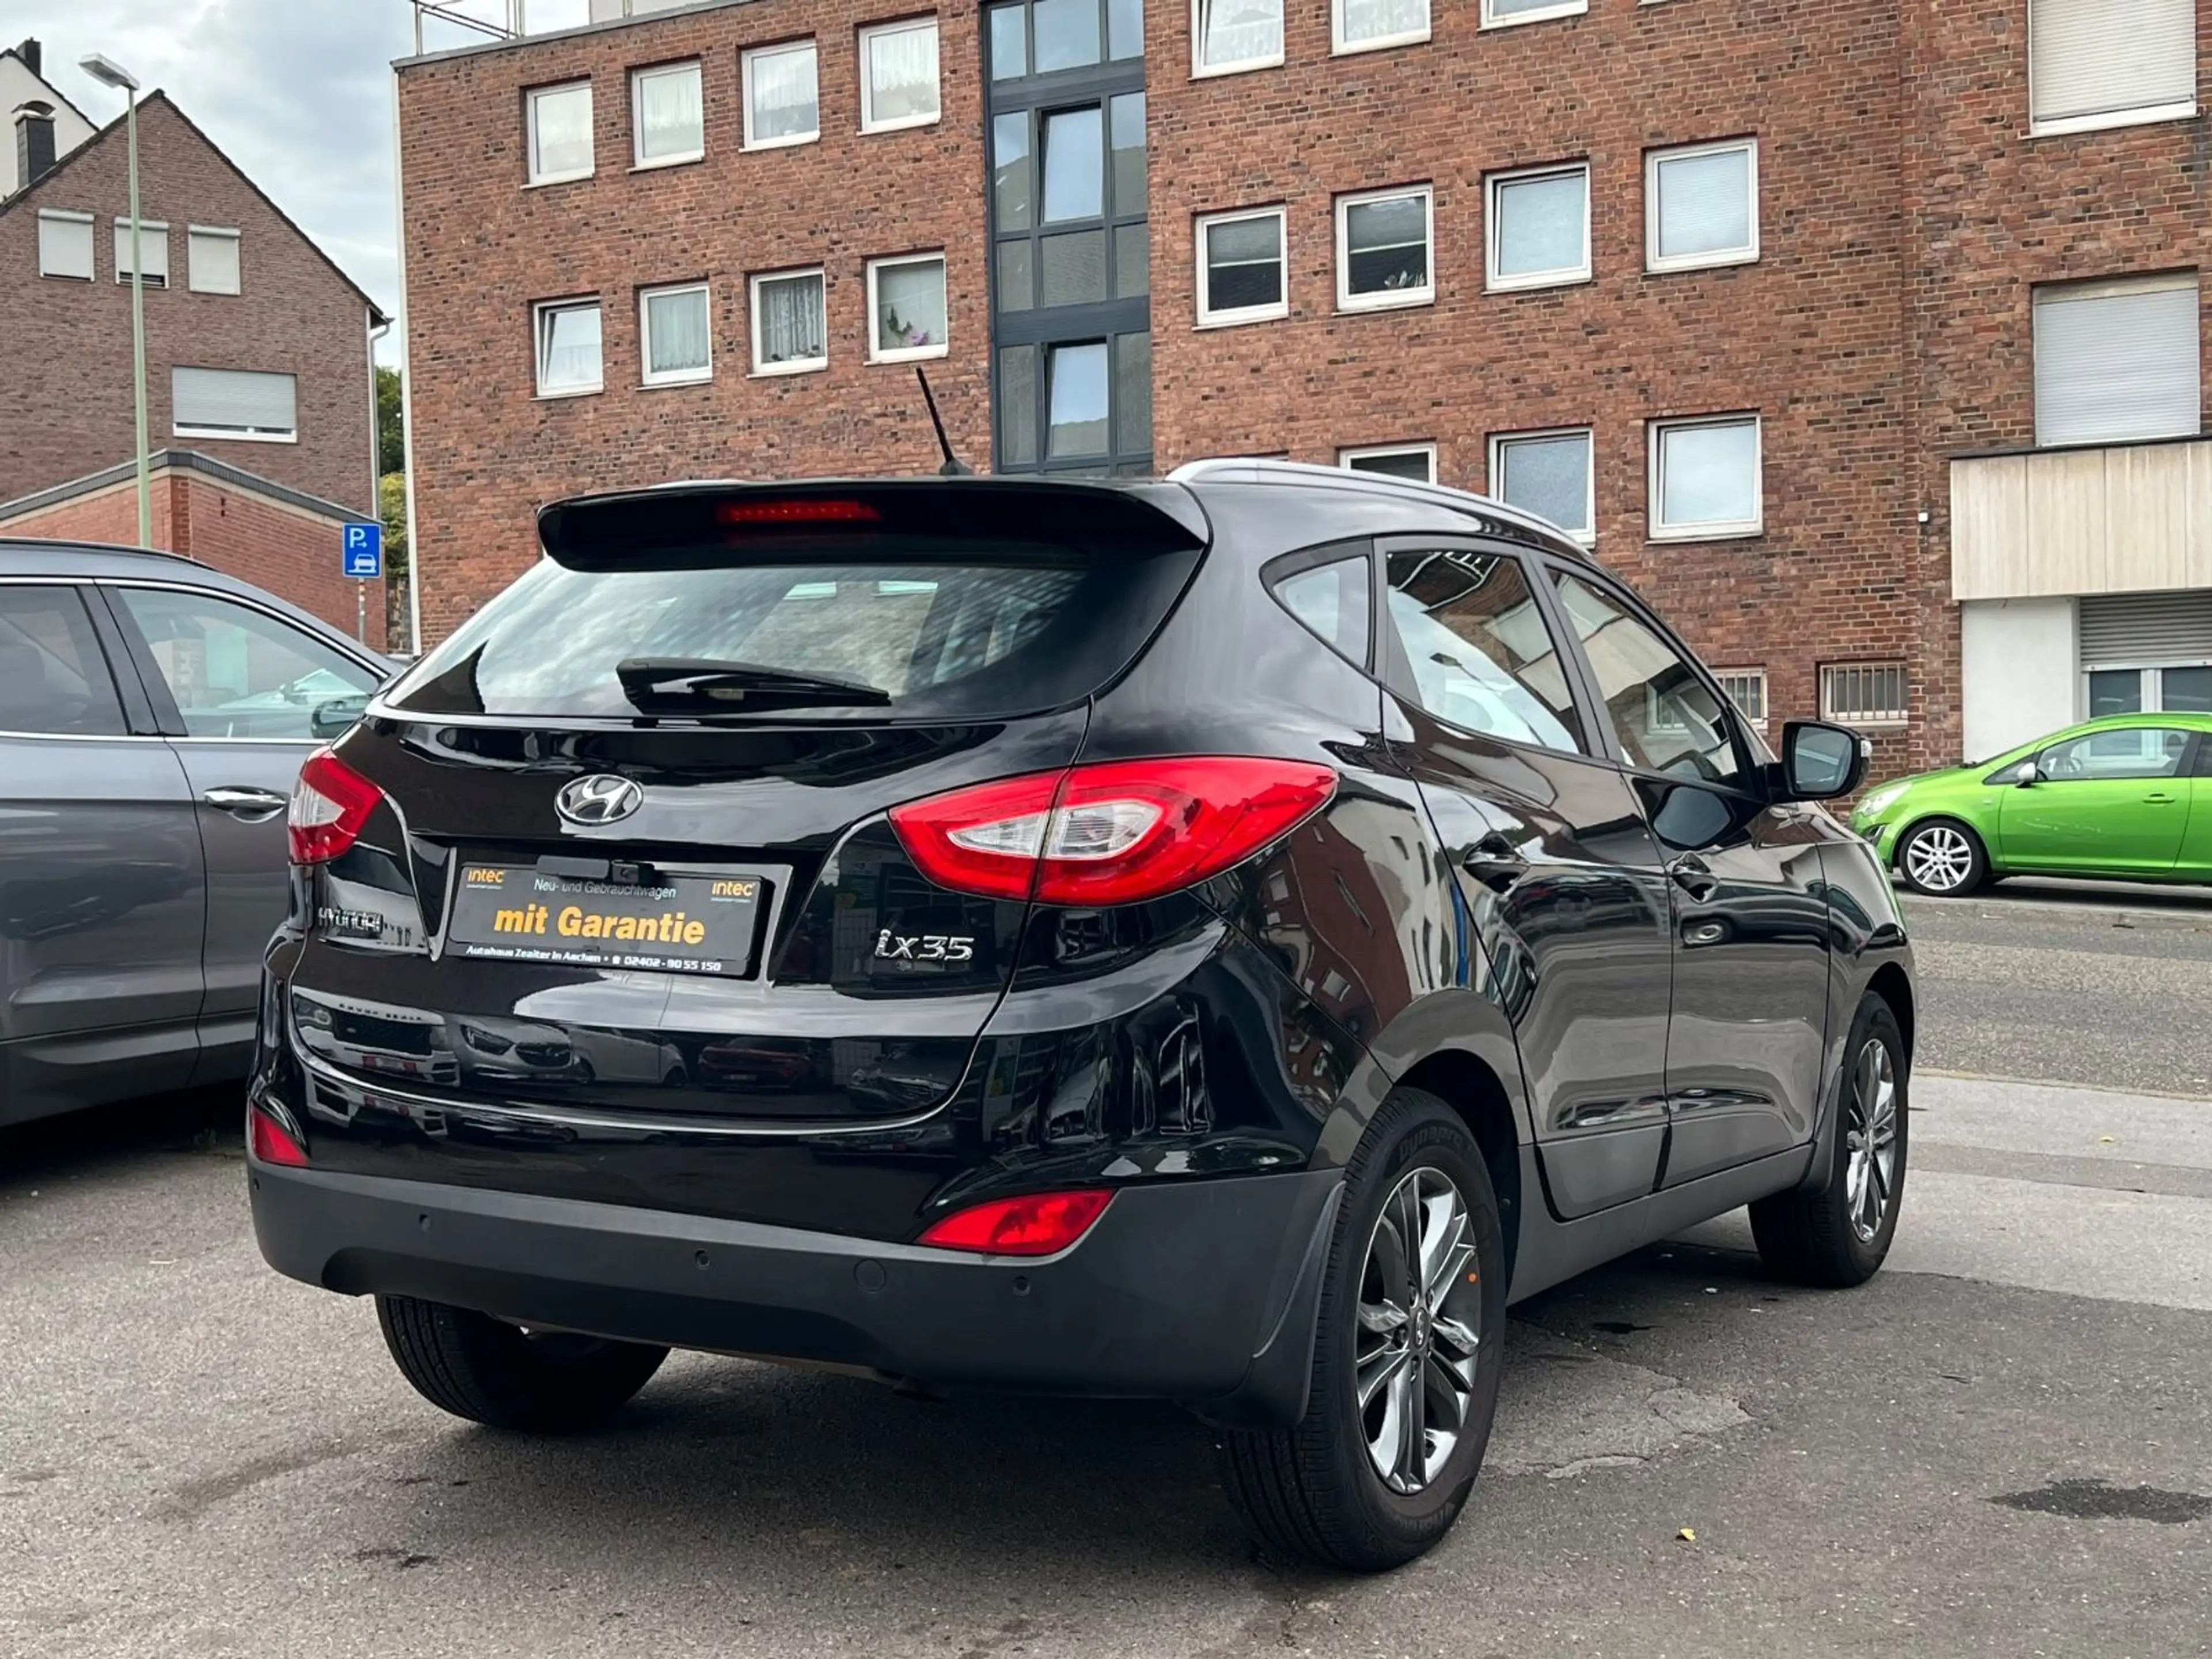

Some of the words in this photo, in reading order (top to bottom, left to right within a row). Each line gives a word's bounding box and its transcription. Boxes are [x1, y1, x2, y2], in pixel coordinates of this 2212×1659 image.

[349, 527, 366, 548] P
[467, 868, 505, 883] intec
[534, 878, 559, 892] Neu-
[562, 881, 582, 893] und
[711, 881, 754, 897] intec
[494, 904, 548, 934] mit
[557, 906, 706, 945] Garantie
[875, 929, 975, 961] ix35
[466, 945, 514, 957] Autohaus
[563, 951, 601, 963] Aachen
[624, 955, 661, 967] 02402
[701, 961, 722, 972] 150
